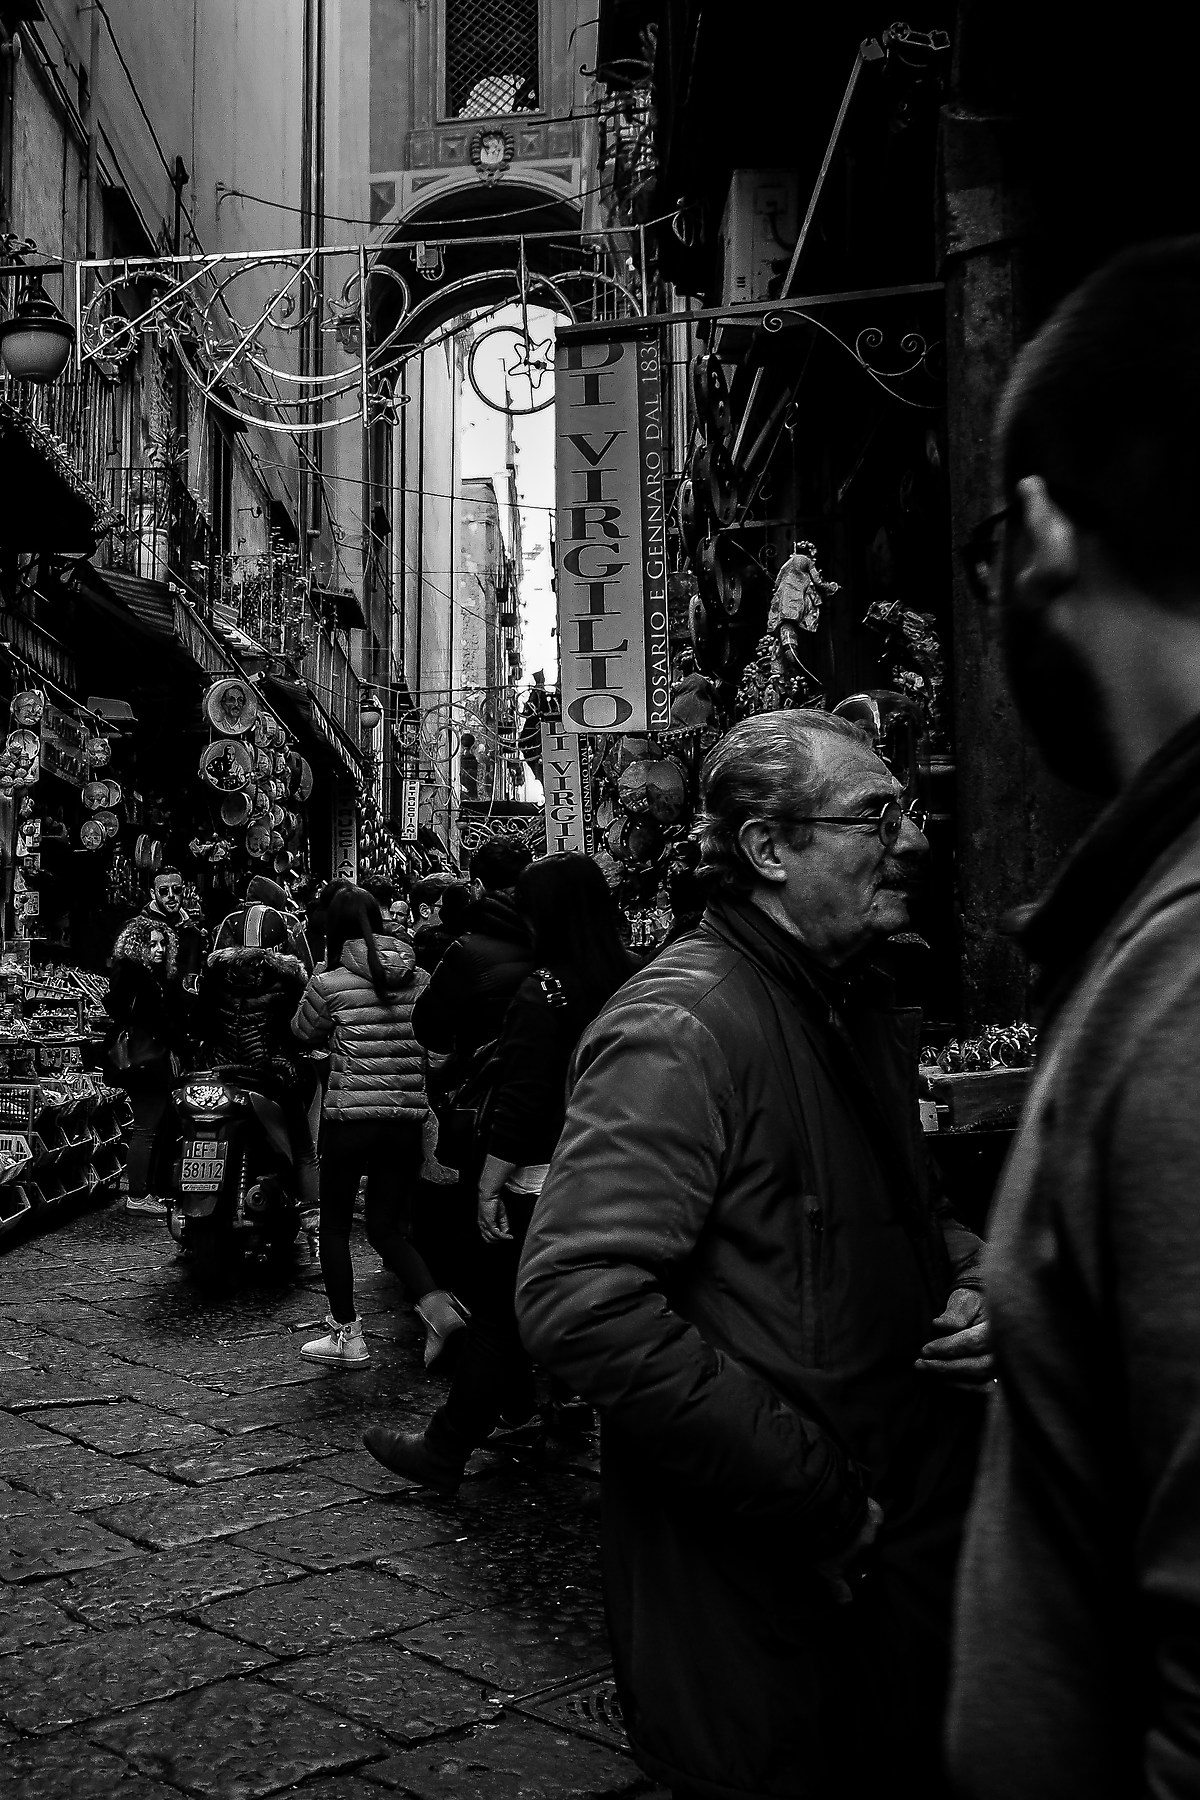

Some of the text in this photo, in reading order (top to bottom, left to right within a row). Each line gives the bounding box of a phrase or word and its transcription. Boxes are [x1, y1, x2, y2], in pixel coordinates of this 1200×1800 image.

[644, 393, 662, 441] DAL
[559, 342, 633, 728] DI VIRGILIO
[645, 451, 665, 580] GENNARO
[649, 589, 665, 601] E
[649, 611, 669, 724] ROSARIO
[183, 1162, 223, 1179] 38112
[194, 1142, 210, 1158] EF
